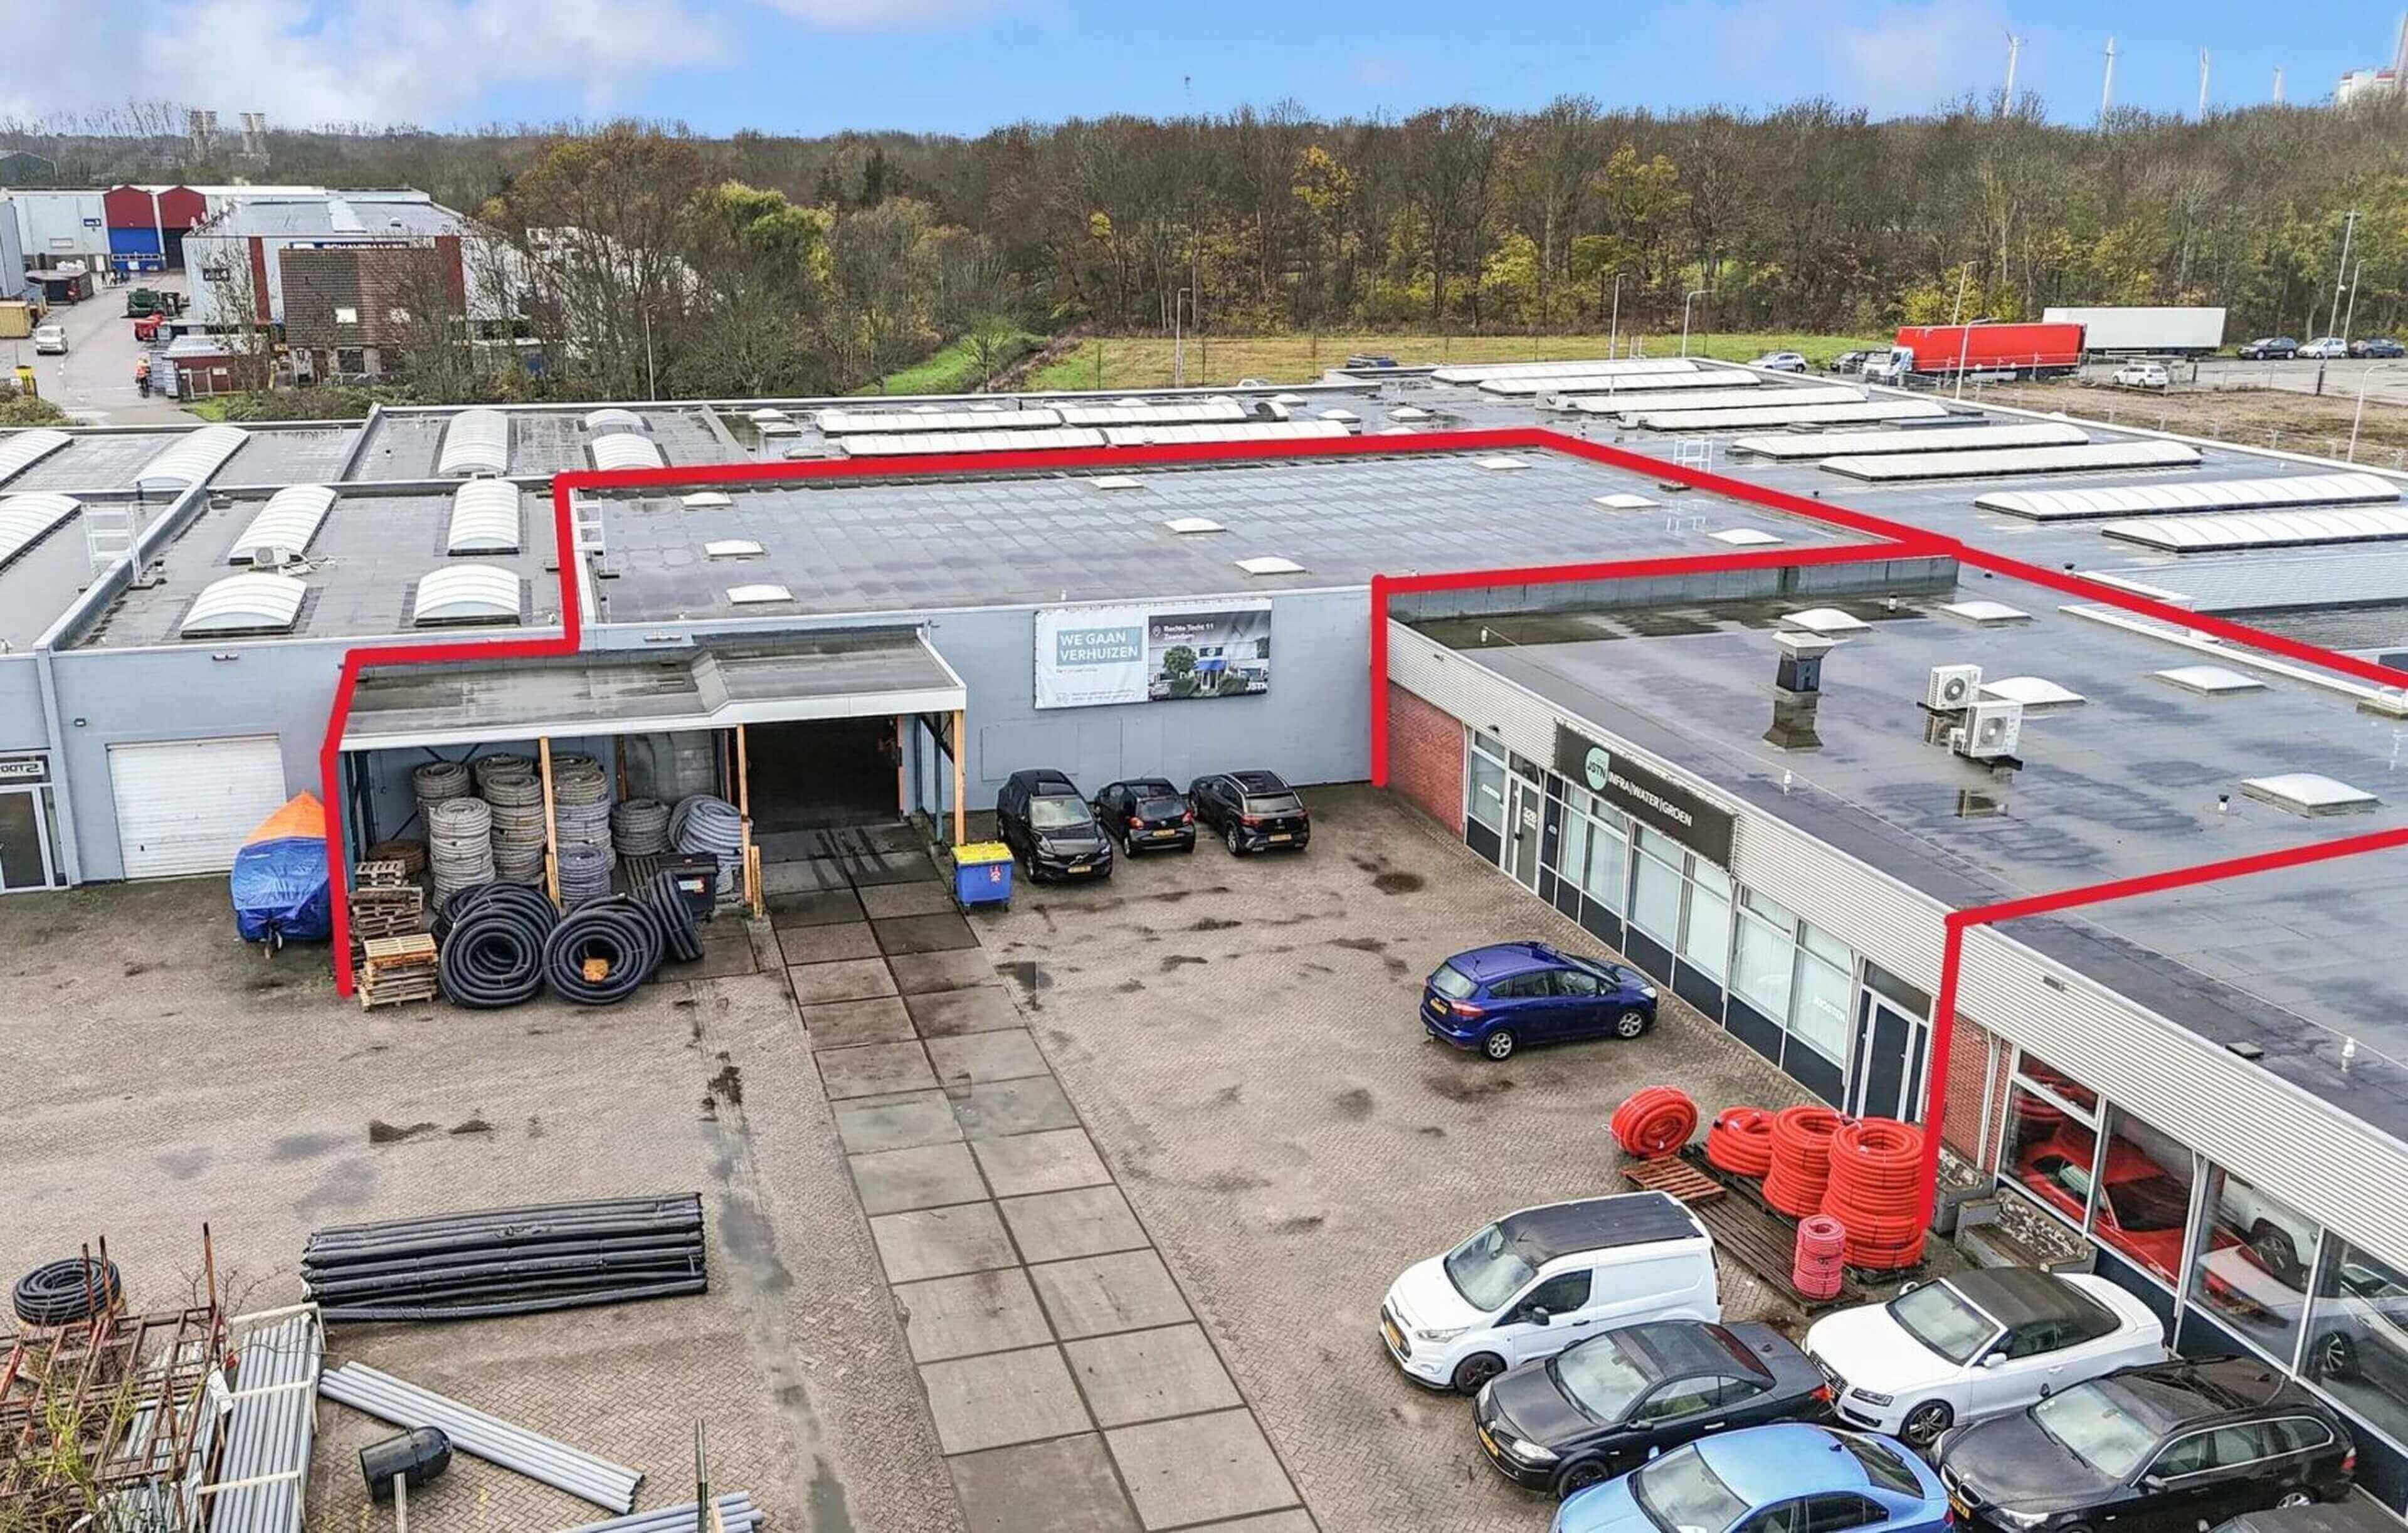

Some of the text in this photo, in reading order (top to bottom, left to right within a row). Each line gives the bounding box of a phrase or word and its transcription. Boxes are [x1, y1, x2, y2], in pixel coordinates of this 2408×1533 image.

[1205, 621, 1214, 630] 11
[1060, 631, 1126, 646] WE GAAN
[1060, 646, 1138, 661] VERHUIZEN
[1587, 760, 1606, 779] JSTN
